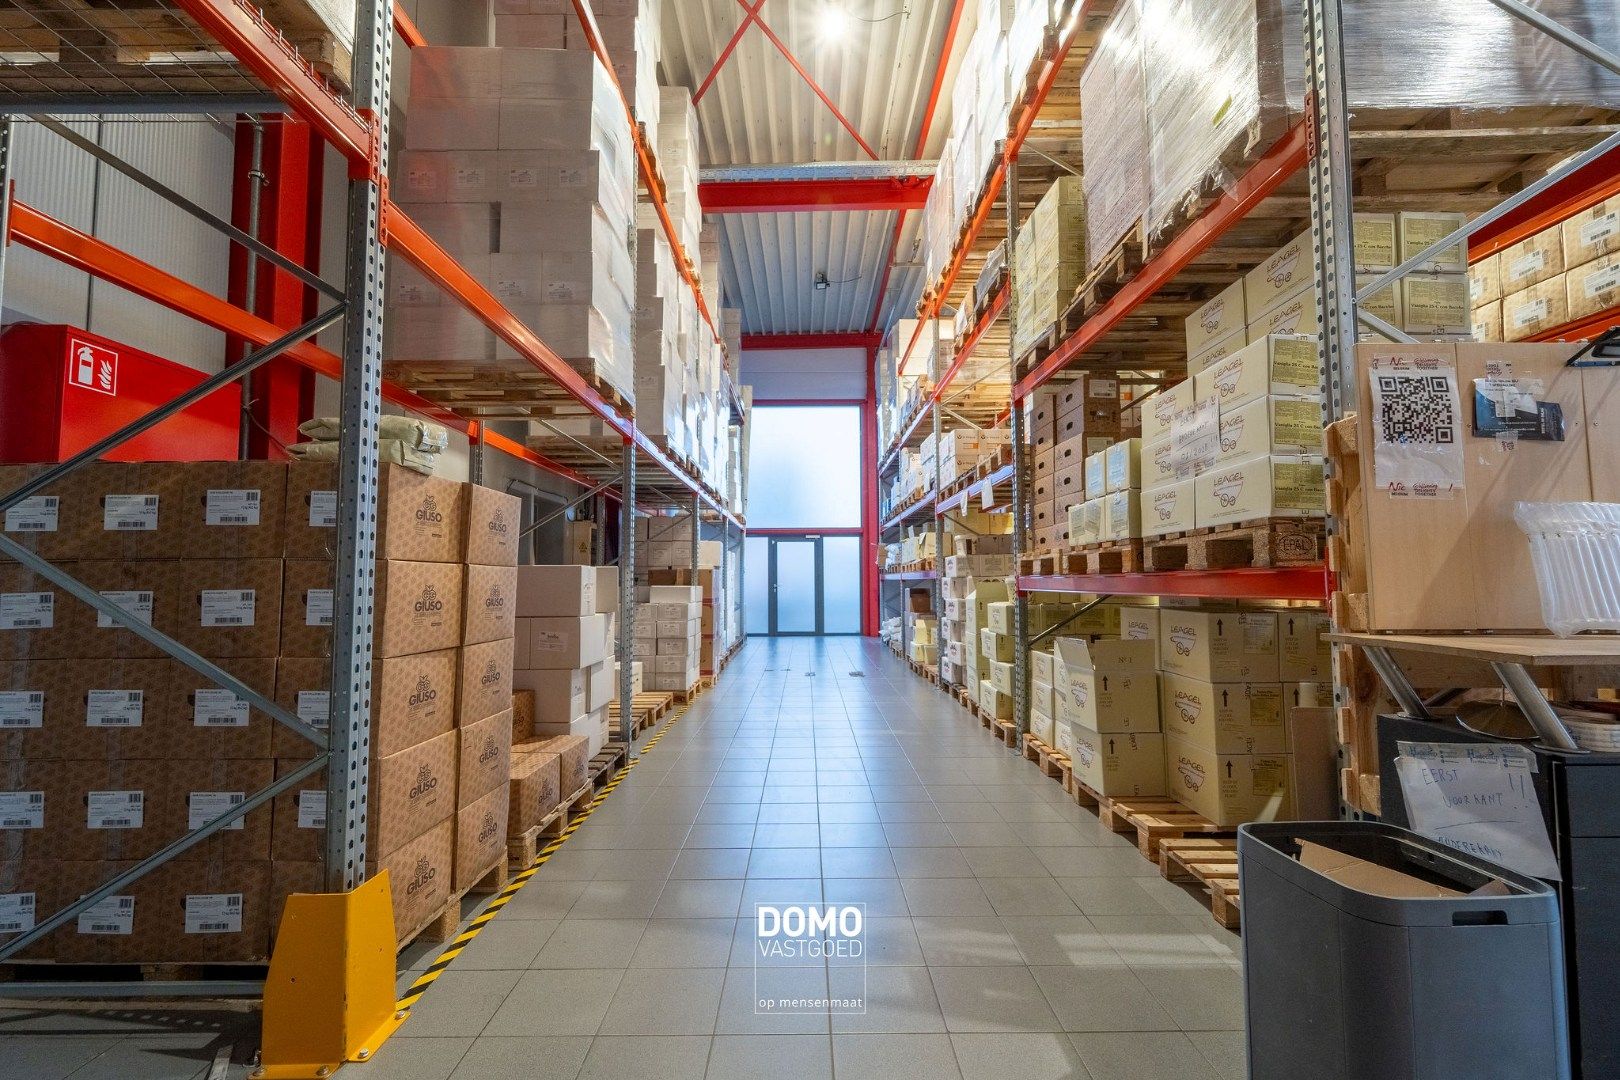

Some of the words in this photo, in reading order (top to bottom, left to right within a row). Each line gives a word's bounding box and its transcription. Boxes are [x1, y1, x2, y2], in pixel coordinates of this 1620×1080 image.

[1266, 244, 1302, 273] LEAGEL
[1200, 299, 1224, 319] LEAGEL
[1269, 301, 1303, 325] LEAGEL
[1203, 347, 1226, 364] LEAGEL
[1214, 358, 1243, 380] LEAGEL
[1155, 394, 1176, 409] LEAGEL
[1220, 415, 1244, 430] EAGEL
[1214, 472, 1244, 486] LEAGEL
[1155, 491, 1176, 501] LEAGEL
[416, 510, 442, 522] GIUSO
[488, 522, 507, 532] GIUSO
[415, 601, 442, 612] GIUSO
[485, 598, 504, 608] GIUSO
[1129, 621, 1149, 630] LEAGEL
[1171, 625, 1197, 636] LEAGEL
[481, 672, 501, 685] GIUSO
[409, 690, 437, 706] GIUSO
[1175, 691, 1202, 705] LEAGEL
[480, 746, 499, 763] GIUSO
[1179, 756, 1206, 773] LEAGEL
[1422, 768, 1457, 785] EERST
[409, 777, 437, 799] GIUSO
[479, 823, 498, 842] GIUSO
[407, 868, 436, 895] GIUSO
